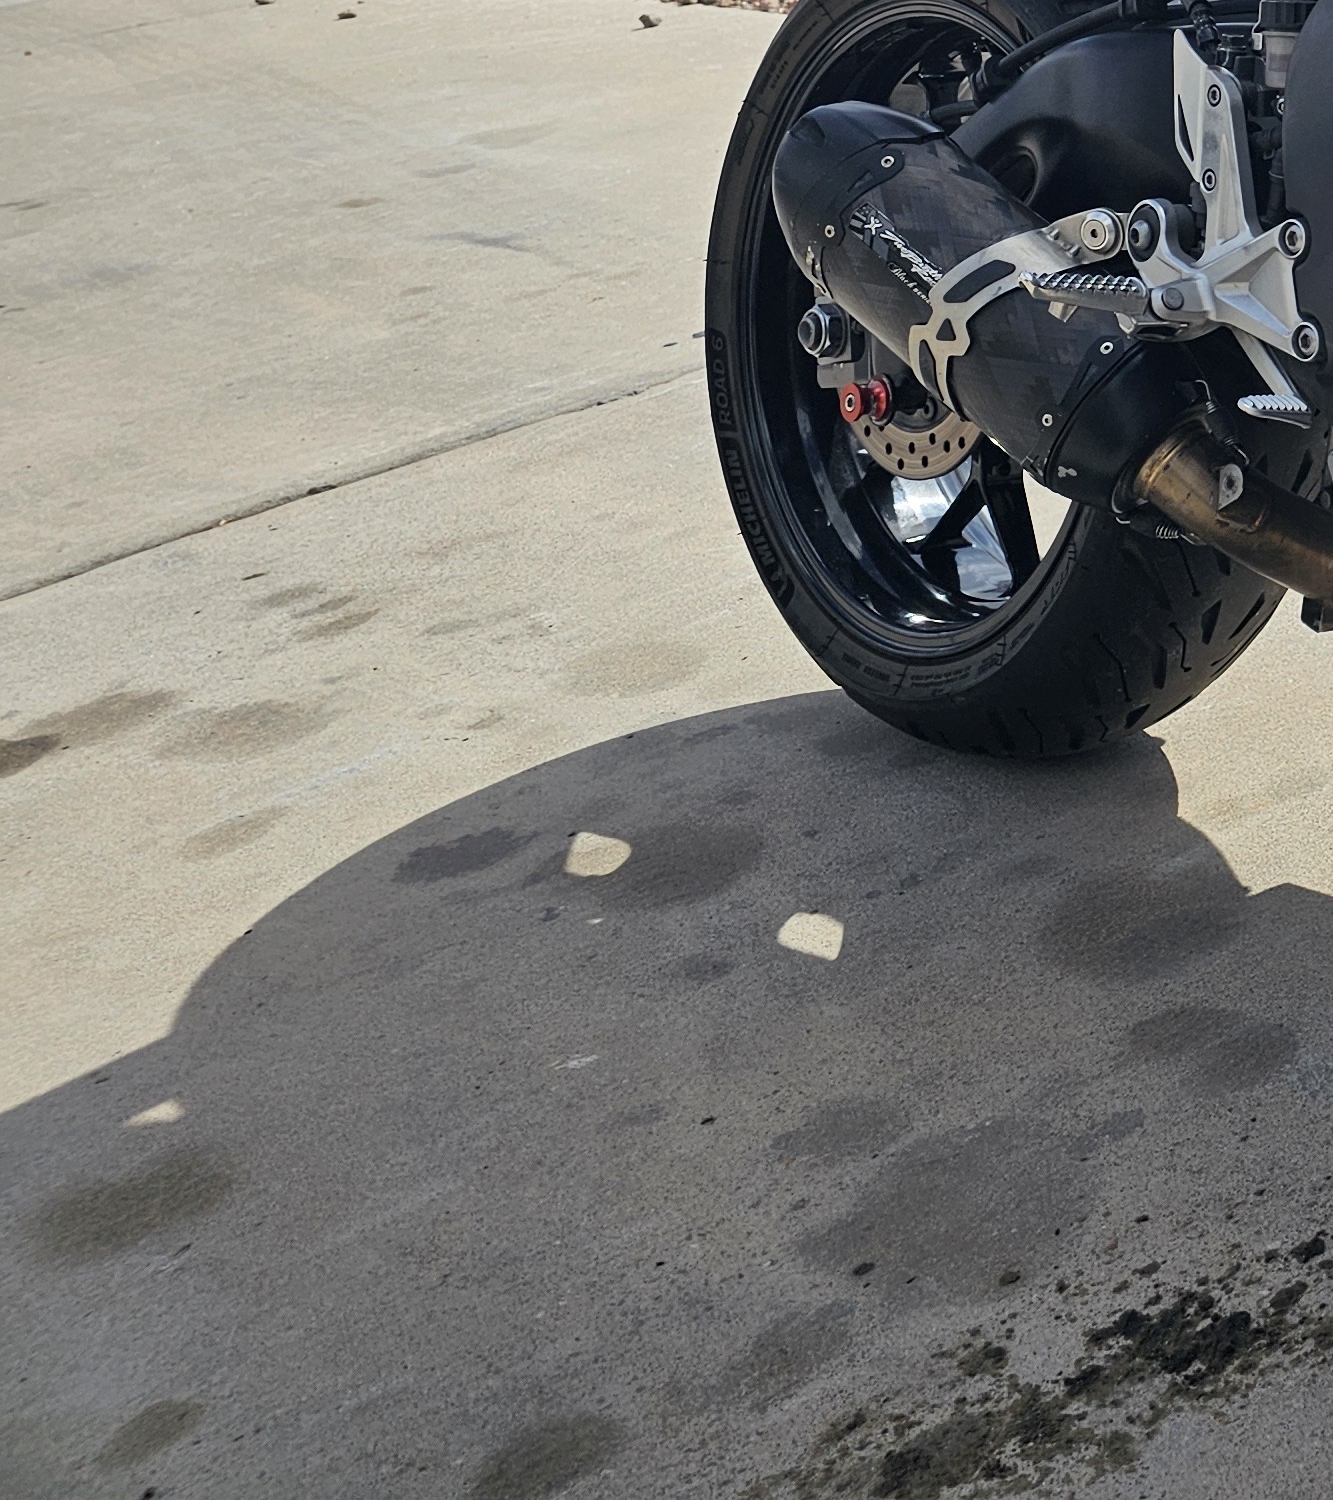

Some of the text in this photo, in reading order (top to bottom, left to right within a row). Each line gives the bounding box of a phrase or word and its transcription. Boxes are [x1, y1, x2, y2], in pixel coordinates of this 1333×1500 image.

[711, 335, 776, 566] MICHELIN ROAD 6
